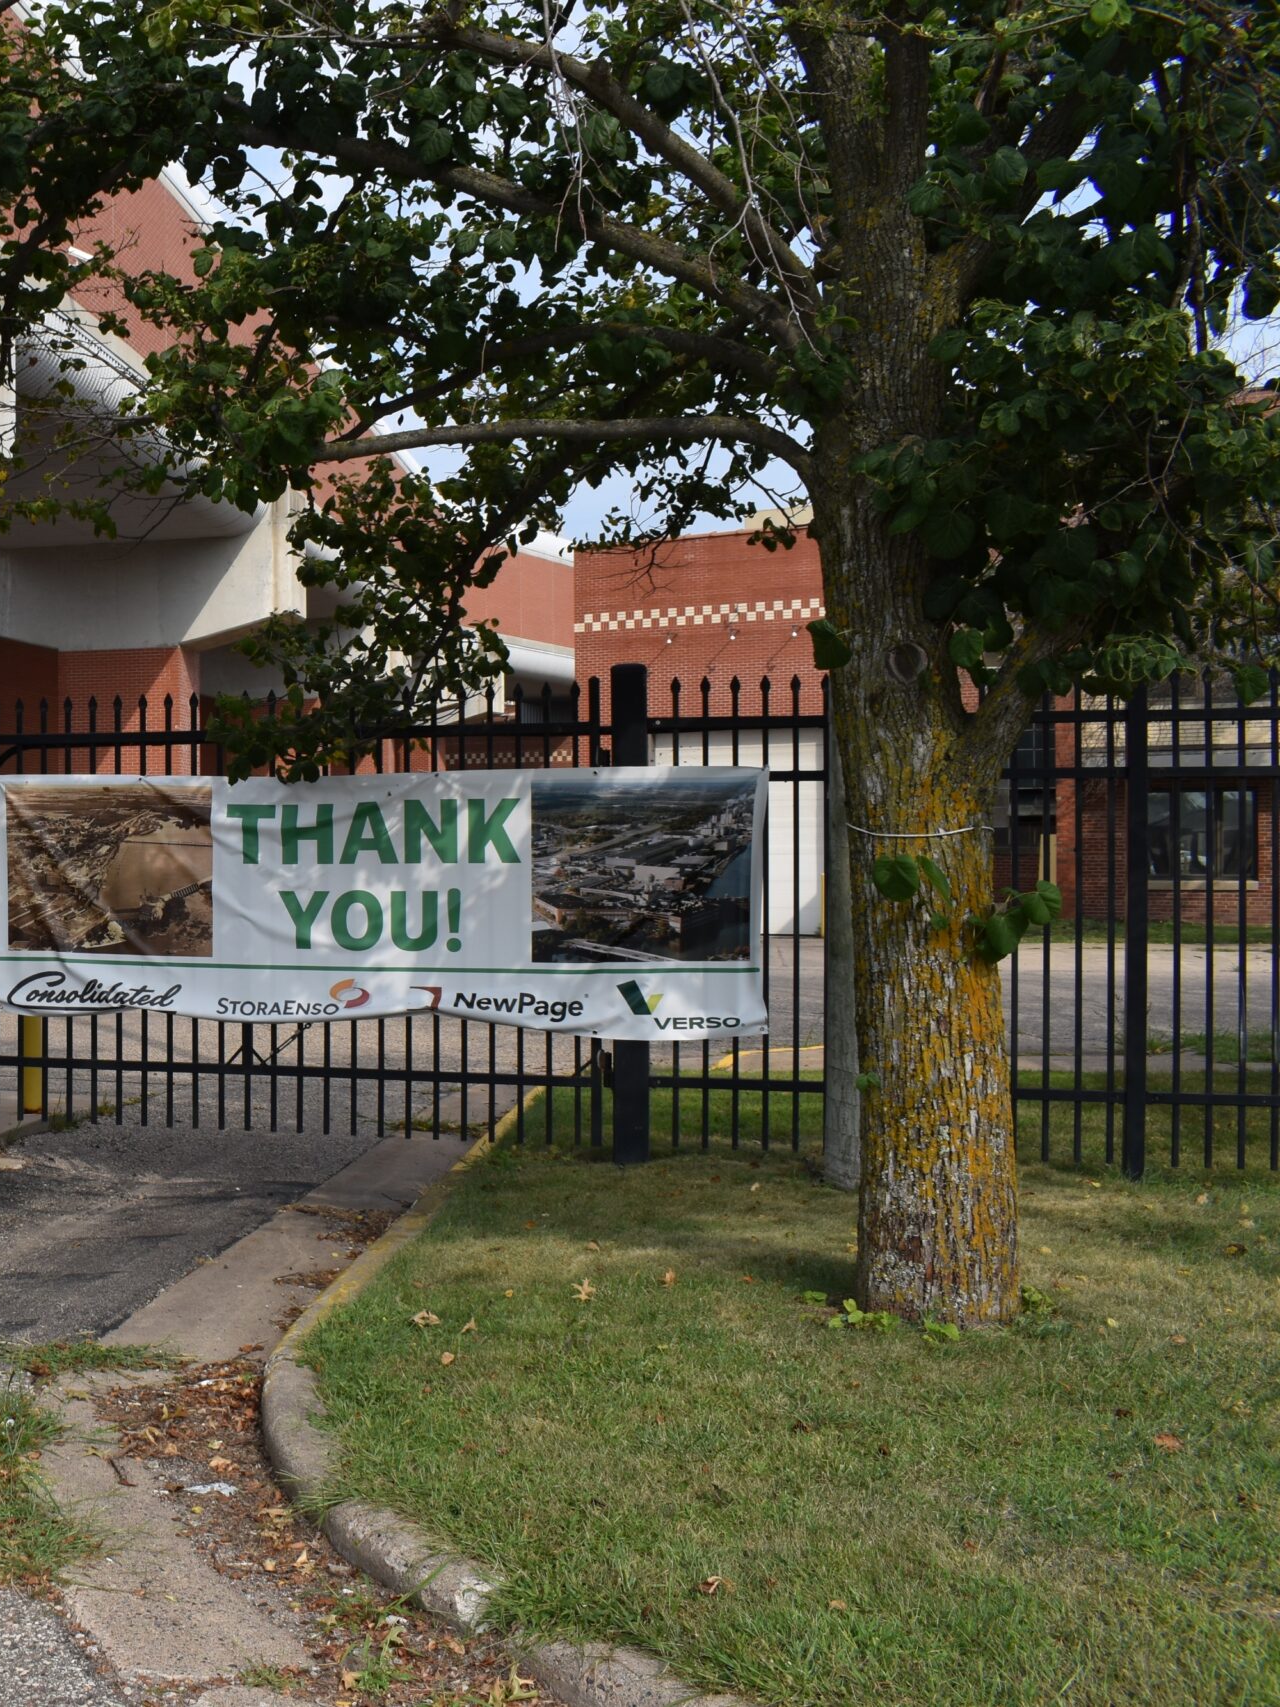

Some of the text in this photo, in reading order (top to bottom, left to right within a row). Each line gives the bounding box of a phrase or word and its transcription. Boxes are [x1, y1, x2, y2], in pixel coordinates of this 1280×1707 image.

[226, 798, 522, 865] THANK
[278, 888, 462, 953] YOU!
[6, 970, 182, 1010] Consolidated
[453, 992, 584, 1023] NewPage
[653, 1016, 741, 1030] VERSO
